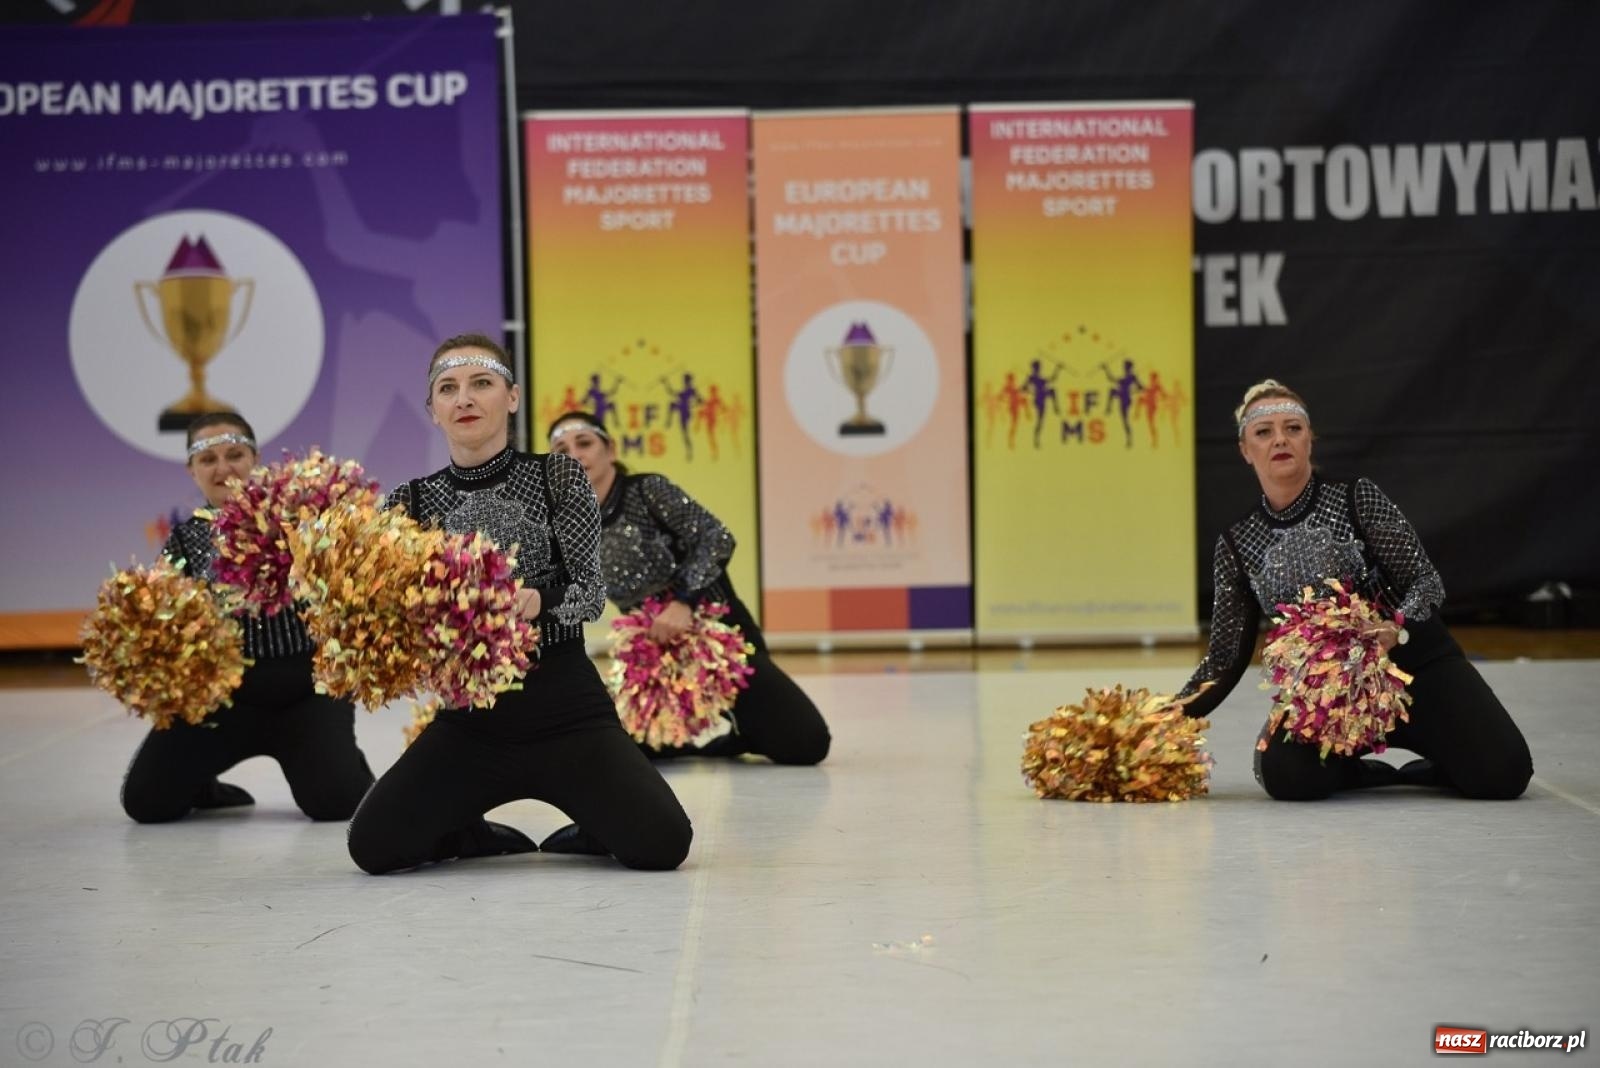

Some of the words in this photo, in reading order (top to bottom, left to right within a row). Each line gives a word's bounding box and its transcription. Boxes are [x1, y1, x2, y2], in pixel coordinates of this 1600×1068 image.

[131, 75, 377, 121] MAJORETTES
[386, 71, 468, 107] CUP
[990, 116, 1168, 140] INTERNATIONAL
[546, 130, 724, 153] INTERNATIONAL
[1010, 143, 1149, 166] FEDERATION
[566, 156, 707, 180] FEDERATION
[1005, 169, 1155, 192] MAJORETTES
[1193, 137, 1600, 223] ORTOWYMA
[562, 182, 712, 206] MAJORETTES
[784, 179, 931, 205] EUROPEAN
[1042, 195, 1118, 218] SPORT
[599, 208, 675, 232] SPORT
[773, 207, 942, 239] MAJORETTES
[830, 240, 888, 267] CUP
[1067, 389, 1099, 416] IF
[622, 430, 666, 459] MS
[1061, 418, 1106, 446] MS
